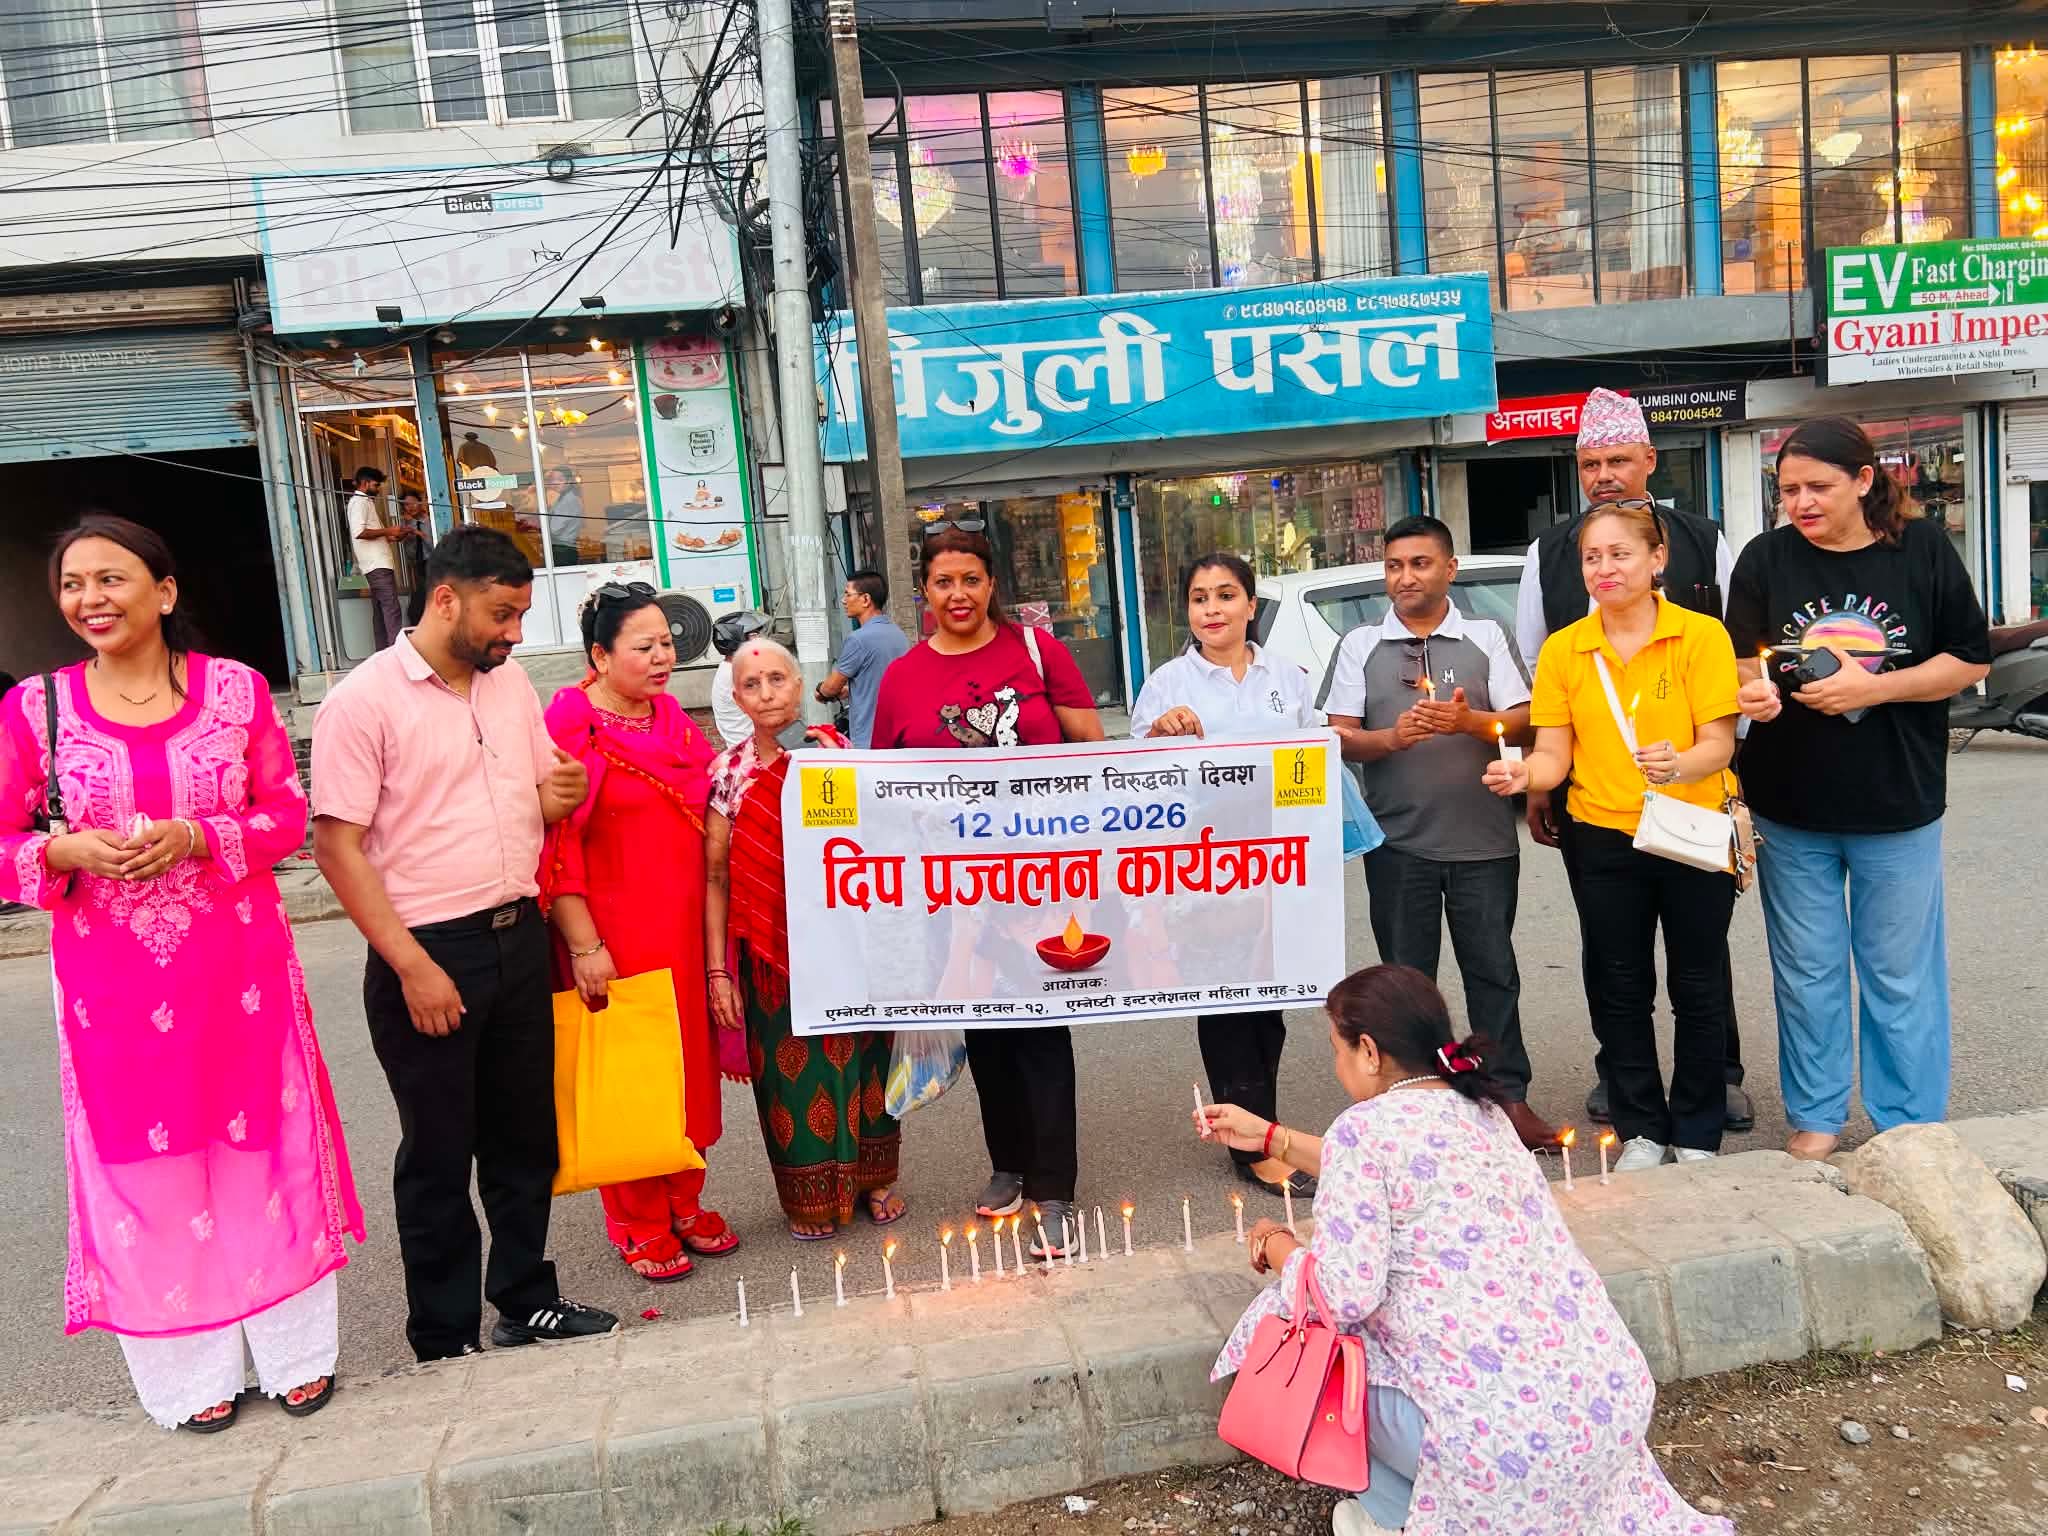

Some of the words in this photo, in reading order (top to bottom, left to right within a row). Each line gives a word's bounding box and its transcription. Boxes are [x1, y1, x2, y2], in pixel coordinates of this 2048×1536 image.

[447, 197, 491, 212] Black
[1911, 257, 1958, 285] Fast
[1833, 252, 1908, 312] EV
[1921, 293, 1936, 304] 50
[1955, 290, 1989, 302] Ahead
[1834, 312, 1940, 356] Gyani
[1204, 313, 1467, 395] पसल
[1872, 357, 1900, 367] Ladies
[1969, 351, 1976, 359] &
[1636, 393, 1687, 408] LUMBINI
[1690, 389, 1737, 404] ONLINE
[1491, 405, 1578, 432] अनलाइन
[1650, 406, 1722, 422] 9847004542
[457, 480, 484, 491] Black
[1783, 596, 1833, 638] CAFE
[1843, 593, 1908, 640] RACER
[1009, 774, 1092, 797] बालश्रम
[1102, 763, 1189, 793] विरुद्धको
[1198, 760, 1256, 787] दिवश
[1274, 798, 1325, 807] INTERNATIONAL
[1277, 787, 1322, 799] AMNESTY
[804, 818, 857, 827] INTERNATIONAL
[805, 808, 856, 820] AMNESTY
[950, 812, 993, 838] 12
[1003, 812, 1090, 837] June
[1101, 802, 1187, 832] 2026
[823, 836, 906, 913] दिप
[921, 848, 1102, 915] प्रज्वलन
[1117, 826, 1310, 898] कार्यक्रम
[1122, 990, 1200, 1007] इन्टरनेशनल
[1207, 985, 1250, 1000] महिला
[882, 1002, 964, 1017] इन्टरनेशनल
